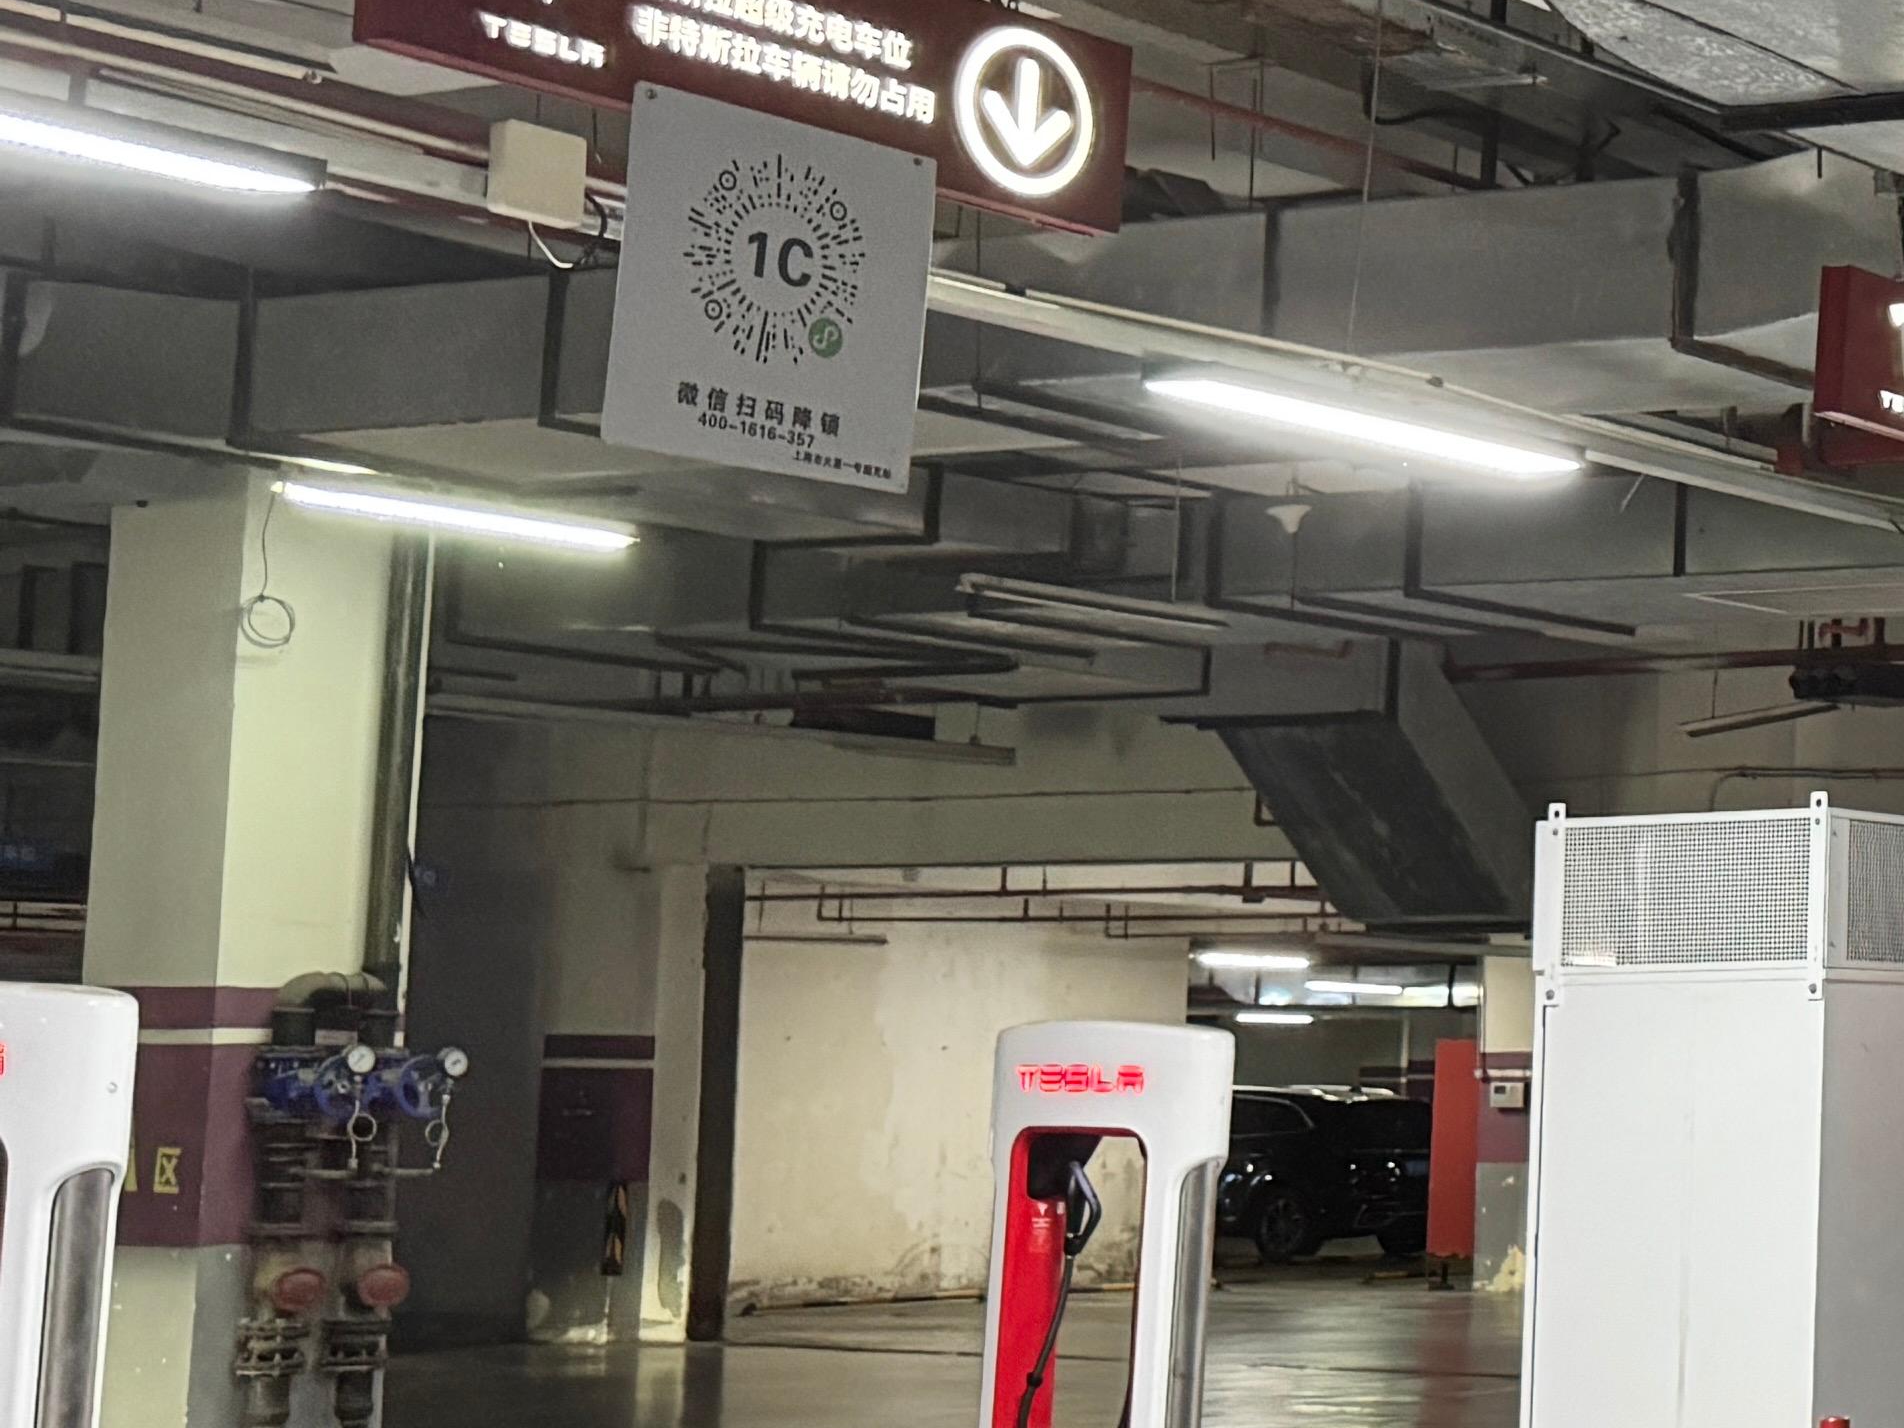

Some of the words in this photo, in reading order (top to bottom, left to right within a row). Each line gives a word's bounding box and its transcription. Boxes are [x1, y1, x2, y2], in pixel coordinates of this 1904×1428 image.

[479, 11, 606, 69] TESLA
[632, 3, 936, 124] 非特斯拉车辆请勿占用
[748, 231, 814, 289] 1C
[677, 381, 841, 437] 微信扫码降锁
[698, 412, 815, 449] 400-1616-357
[1016, 1063, 1145, 1094] TESLA
